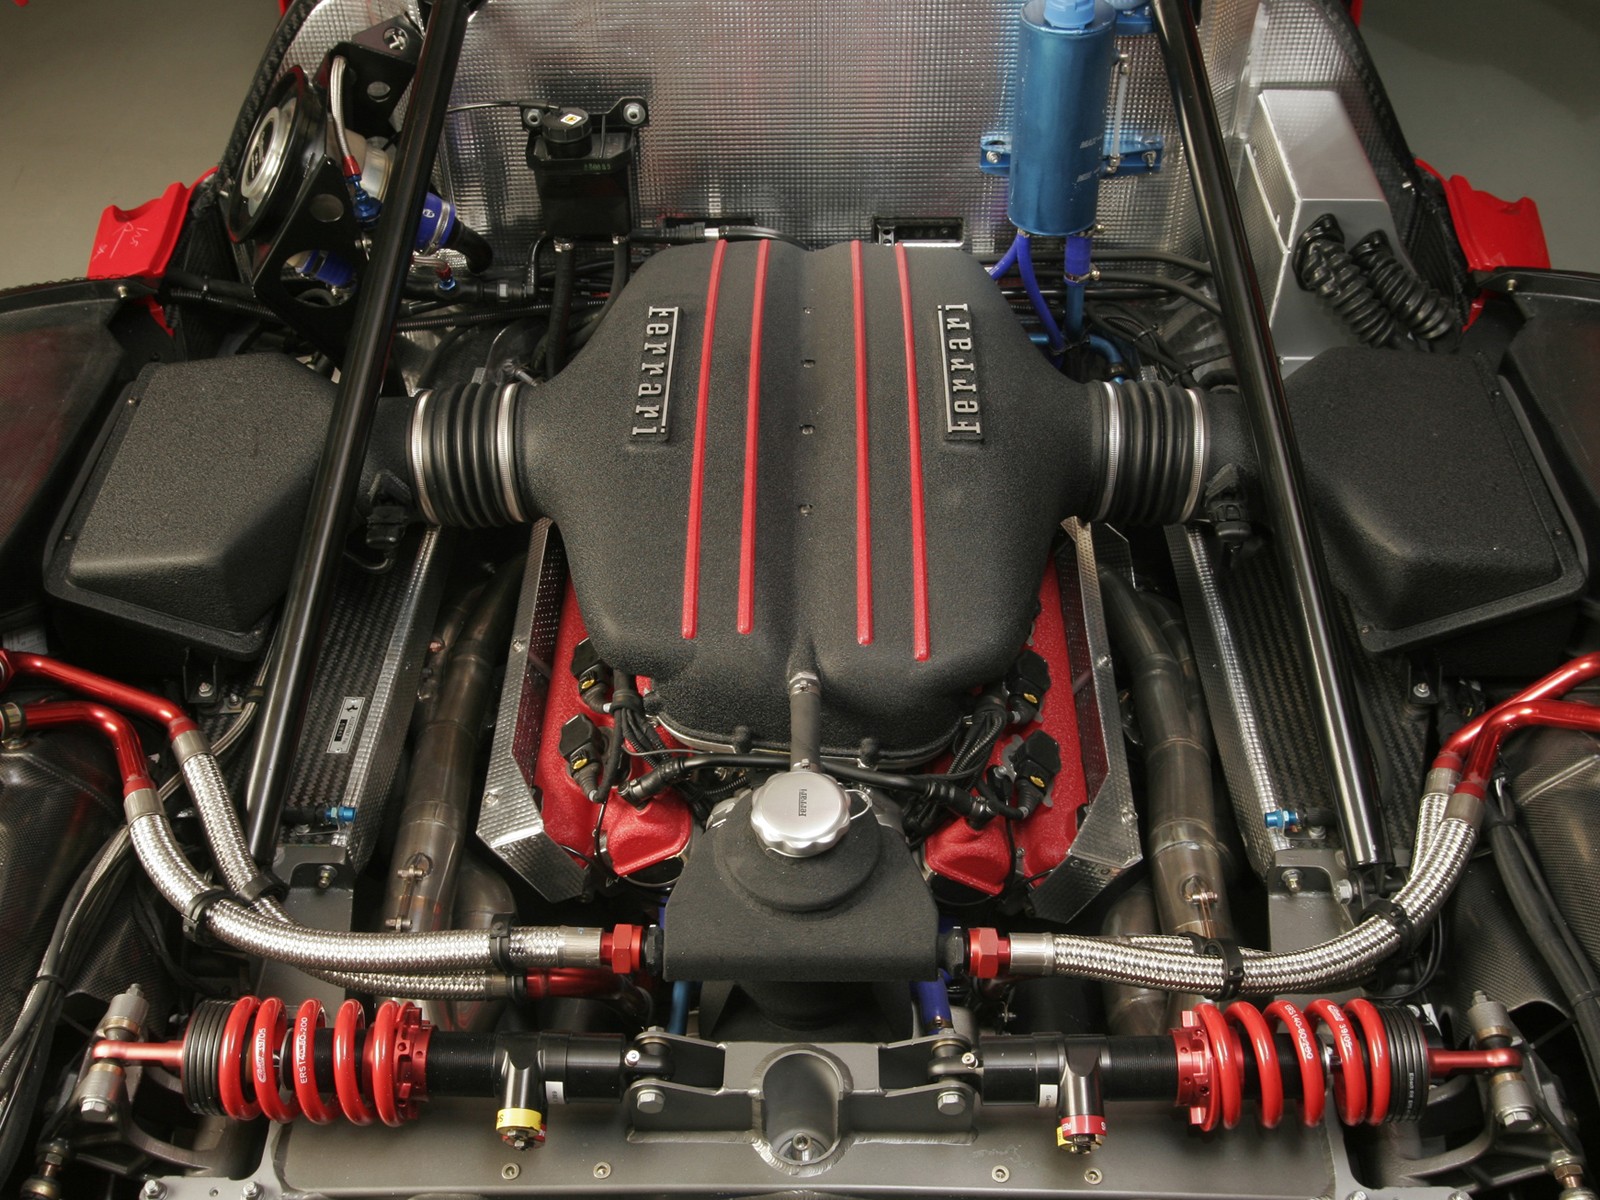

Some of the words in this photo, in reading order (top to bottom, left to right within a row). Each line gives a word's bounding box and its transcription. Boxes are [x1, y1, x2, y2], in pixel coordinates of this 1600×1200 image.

[632, 306, 679, 436] Ferrari
[937, 303, 981, 436] Ferrari
[798, 788, 808, 817] Ferrari
